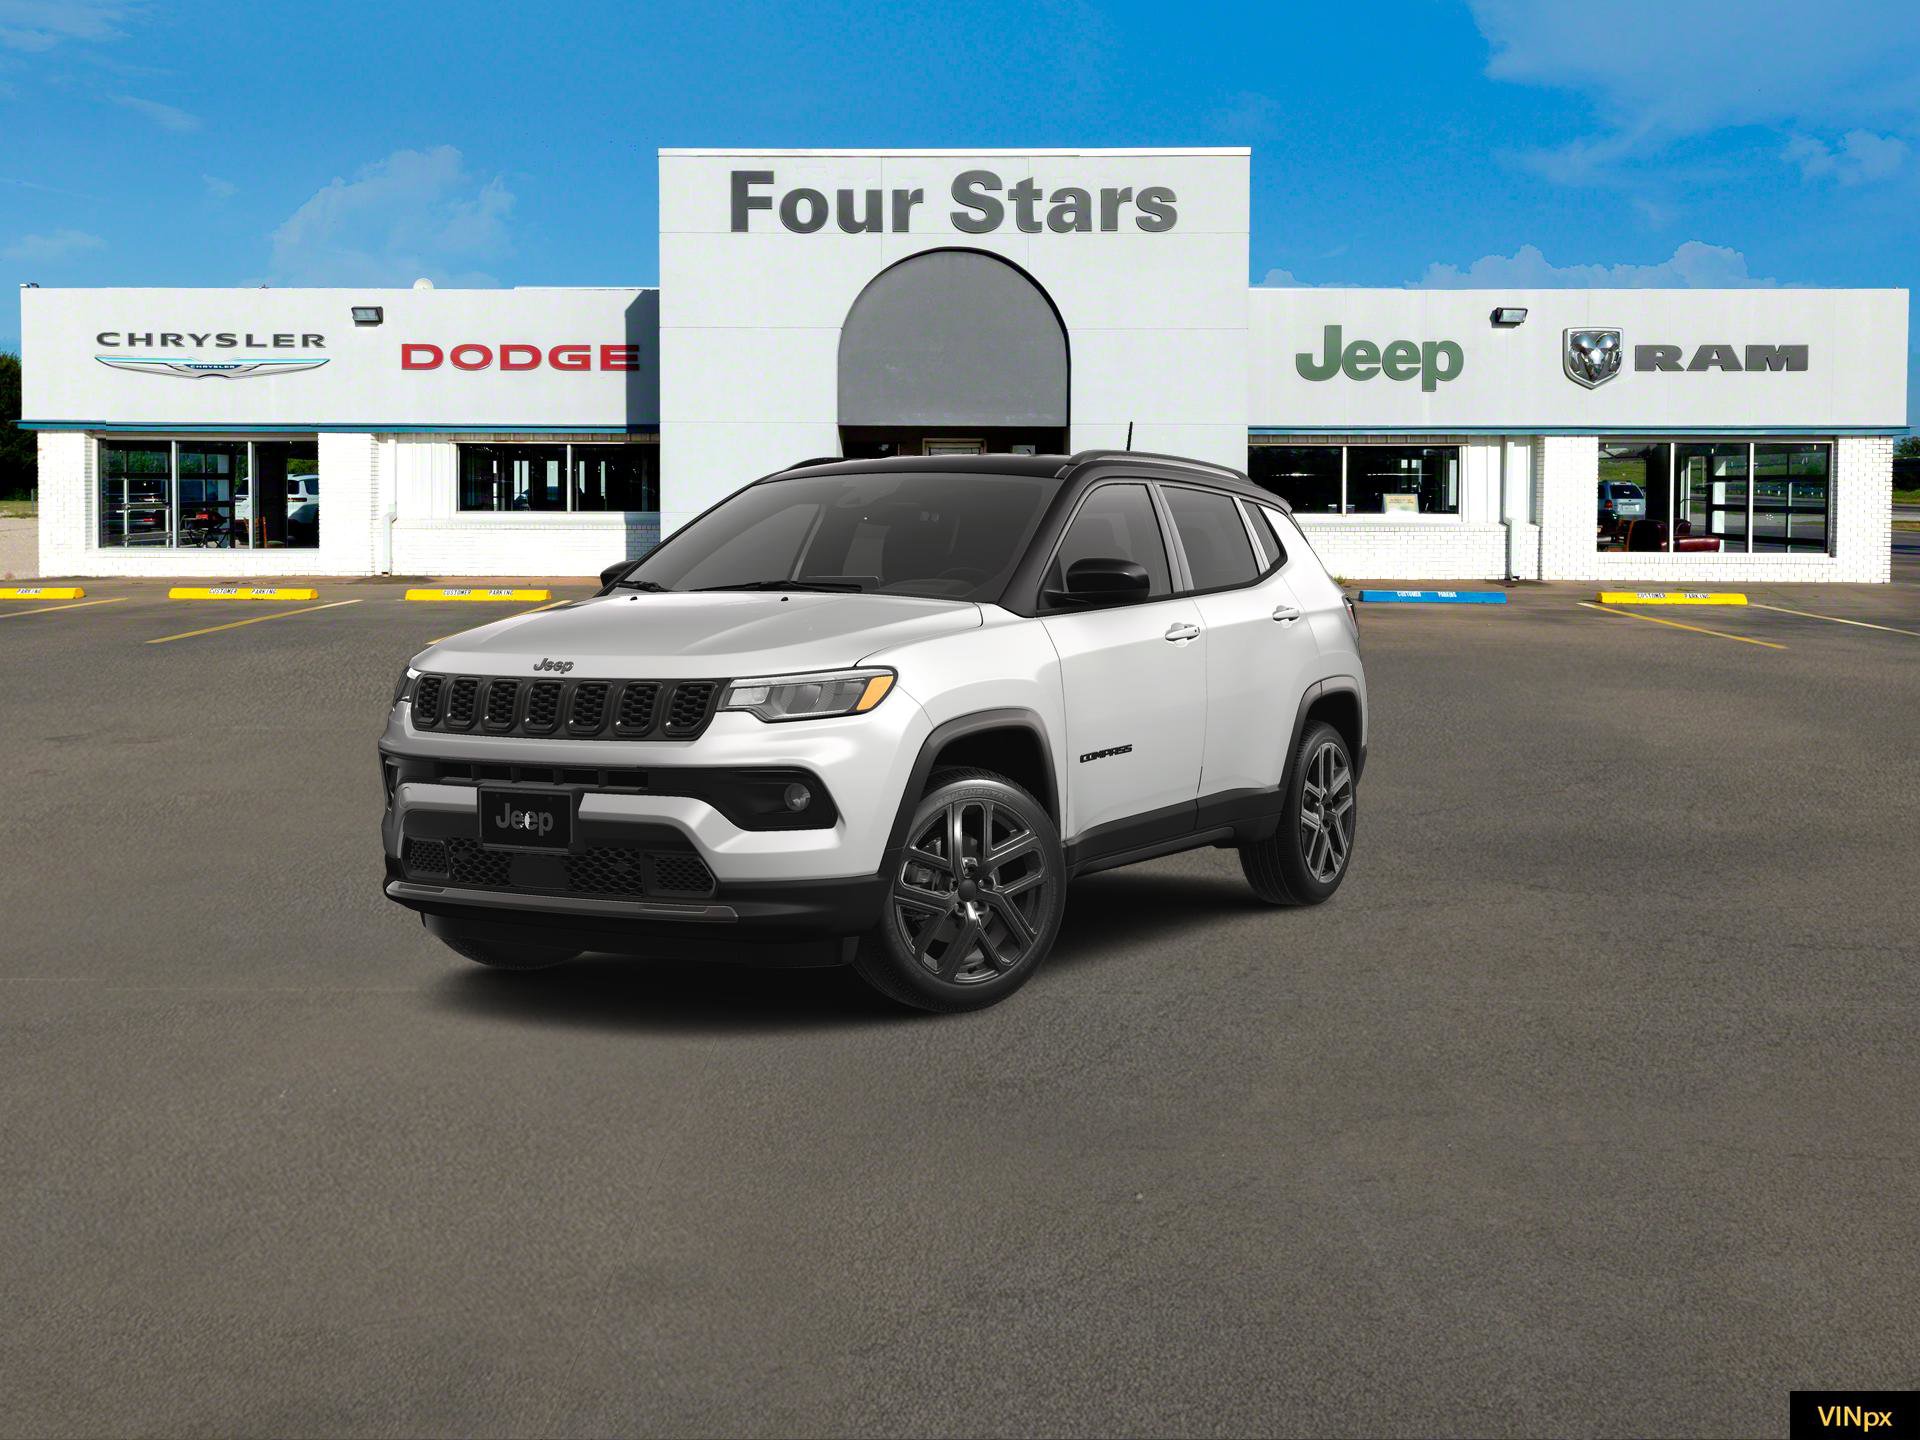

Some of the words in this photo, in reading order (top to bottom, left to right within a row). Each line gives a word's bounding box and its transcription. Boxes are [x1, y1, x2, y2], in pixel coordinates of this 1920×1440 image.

[731, 170, 924, 233] Four
[950, 169, 1178, 233] Stars
[96, 332, 326, 348] CHRYSLER
[401, 343, 640, 371] DODGE
[1296, 325, 1464, 392] Jeep
[1635, 345, 1809, 371] RAM
[533, 657, 574, 674] Jeep
[1079, 744, 1132, 763] COMPASS
[496, 803, 553, 836] Jeep
